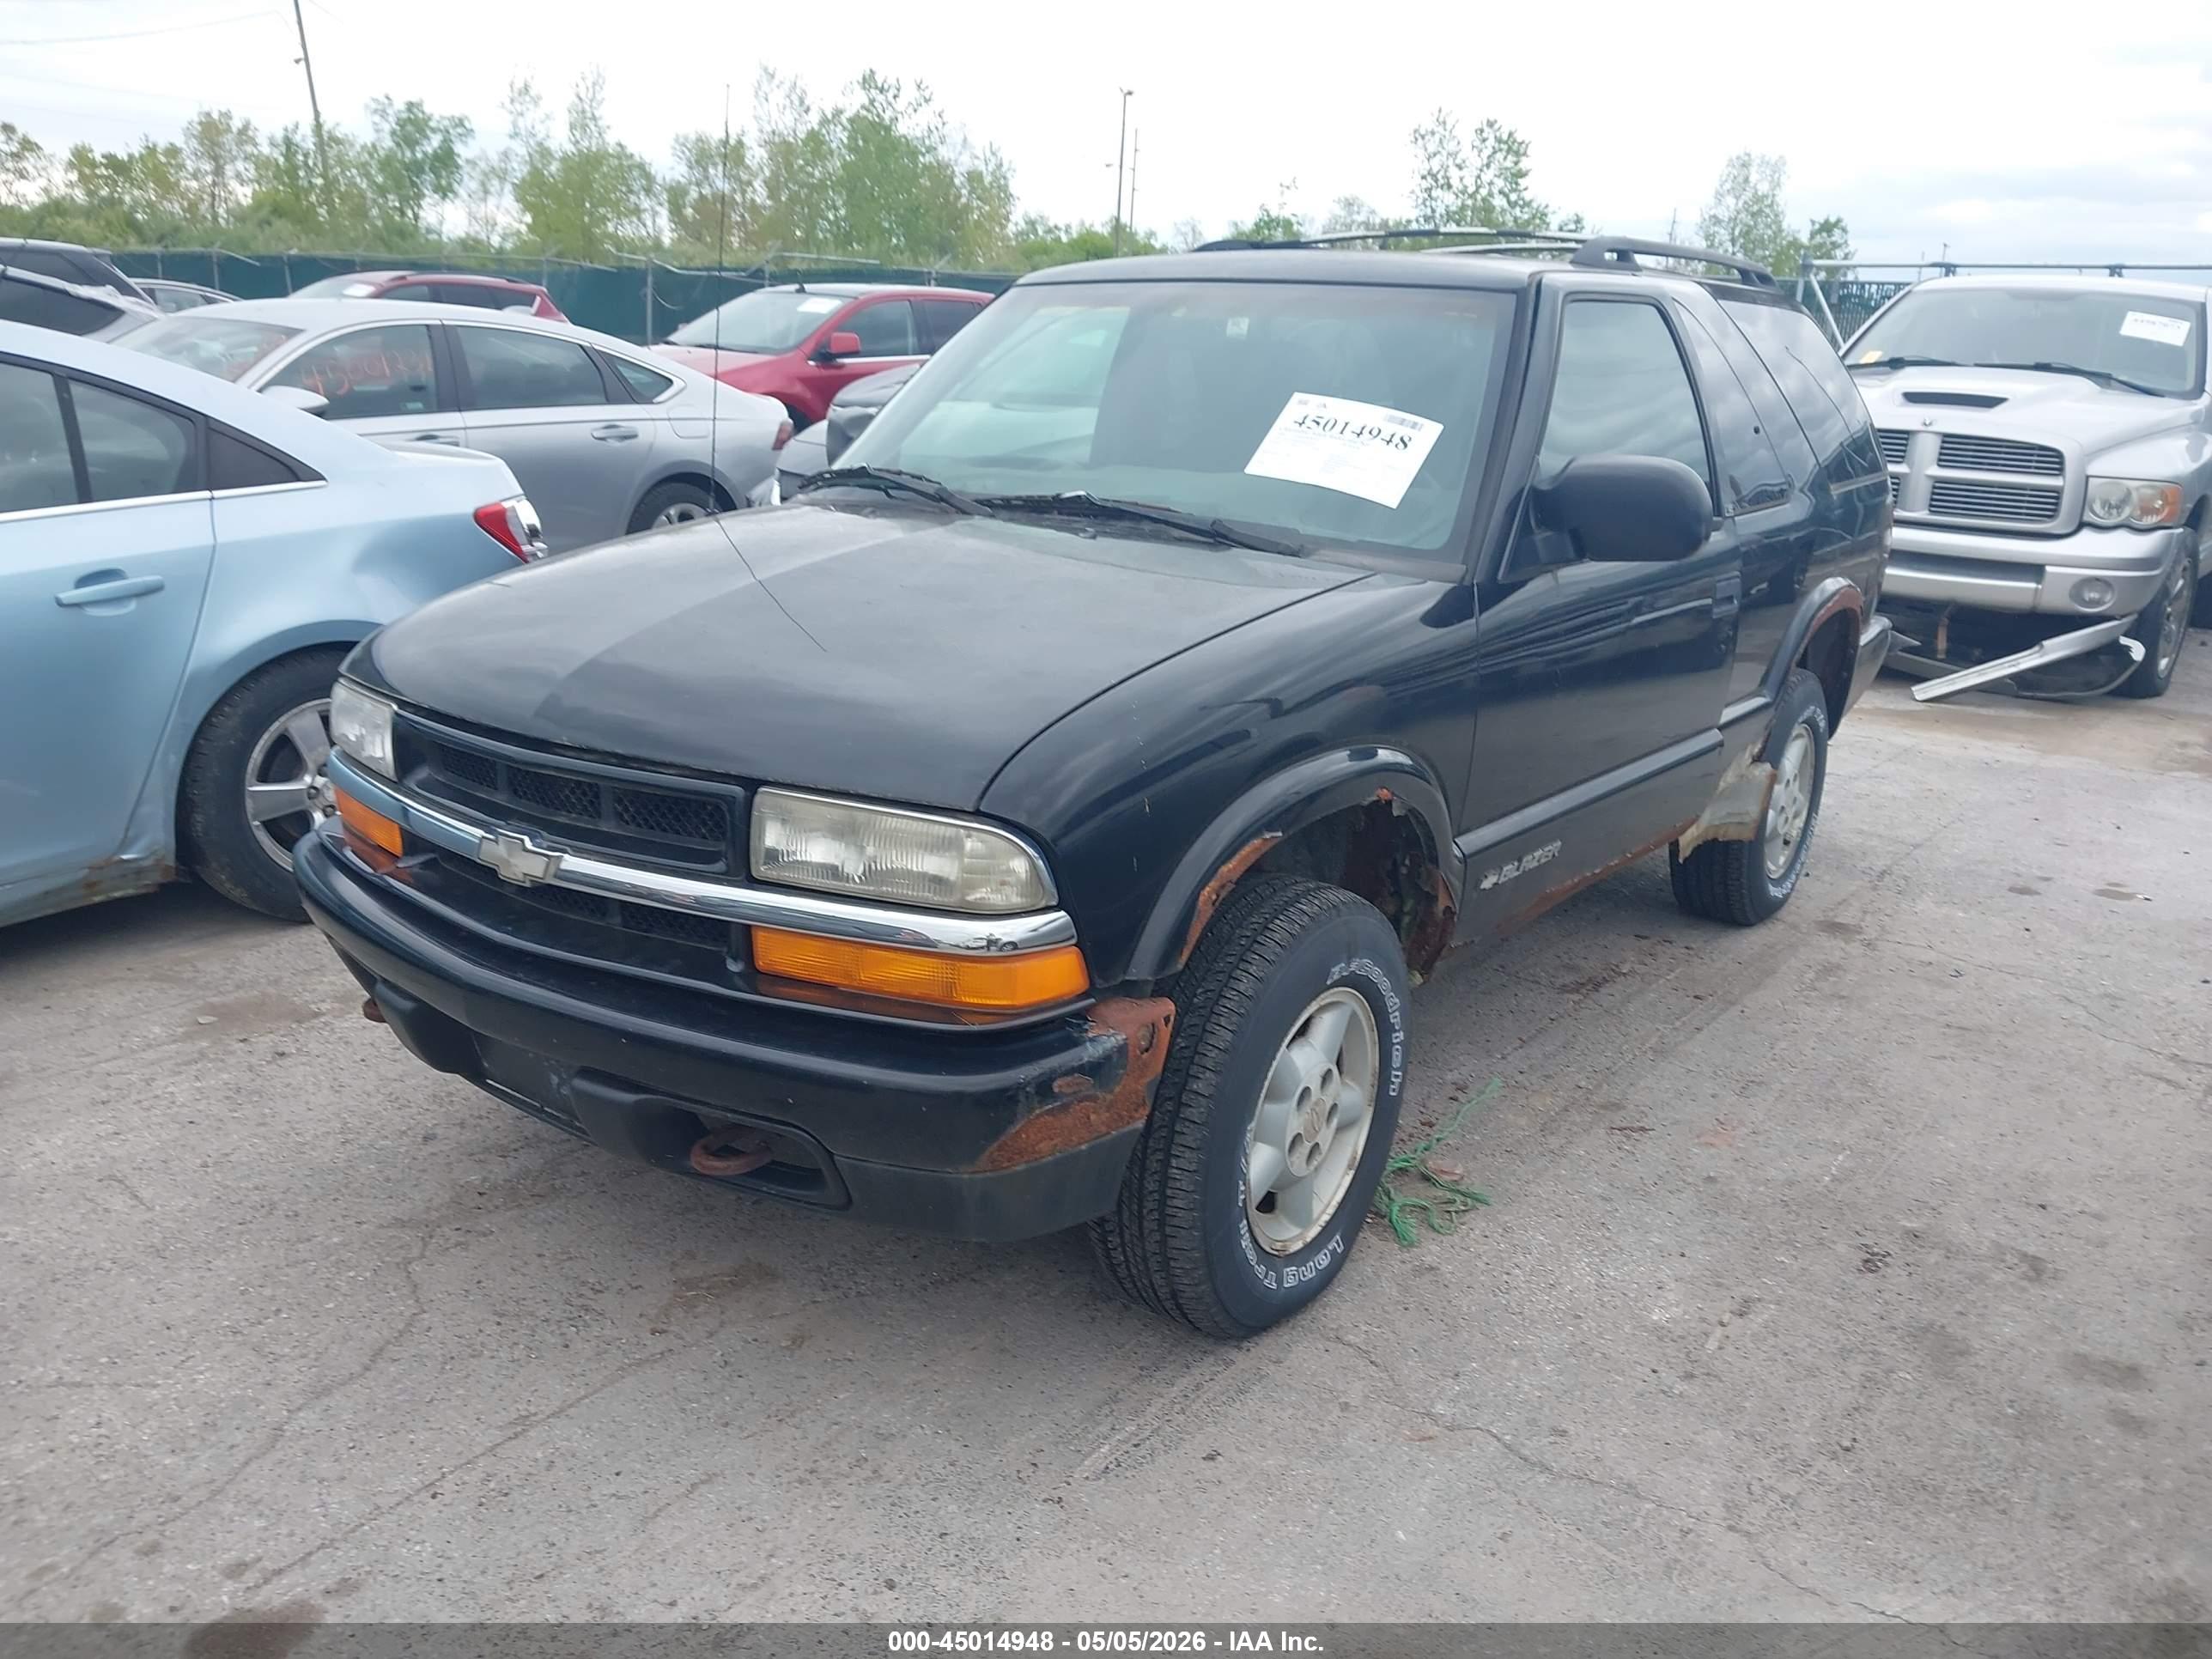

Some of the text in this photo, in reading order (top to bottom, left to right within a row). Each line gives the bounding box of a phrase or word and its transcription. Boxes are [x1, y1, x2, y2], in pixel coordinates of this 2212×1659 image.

[1293, 413, 1413, 451] 45014948
[1498, 838, 1562, 884] BLAZER
[1283, 1235, 1346, 1289] Long
